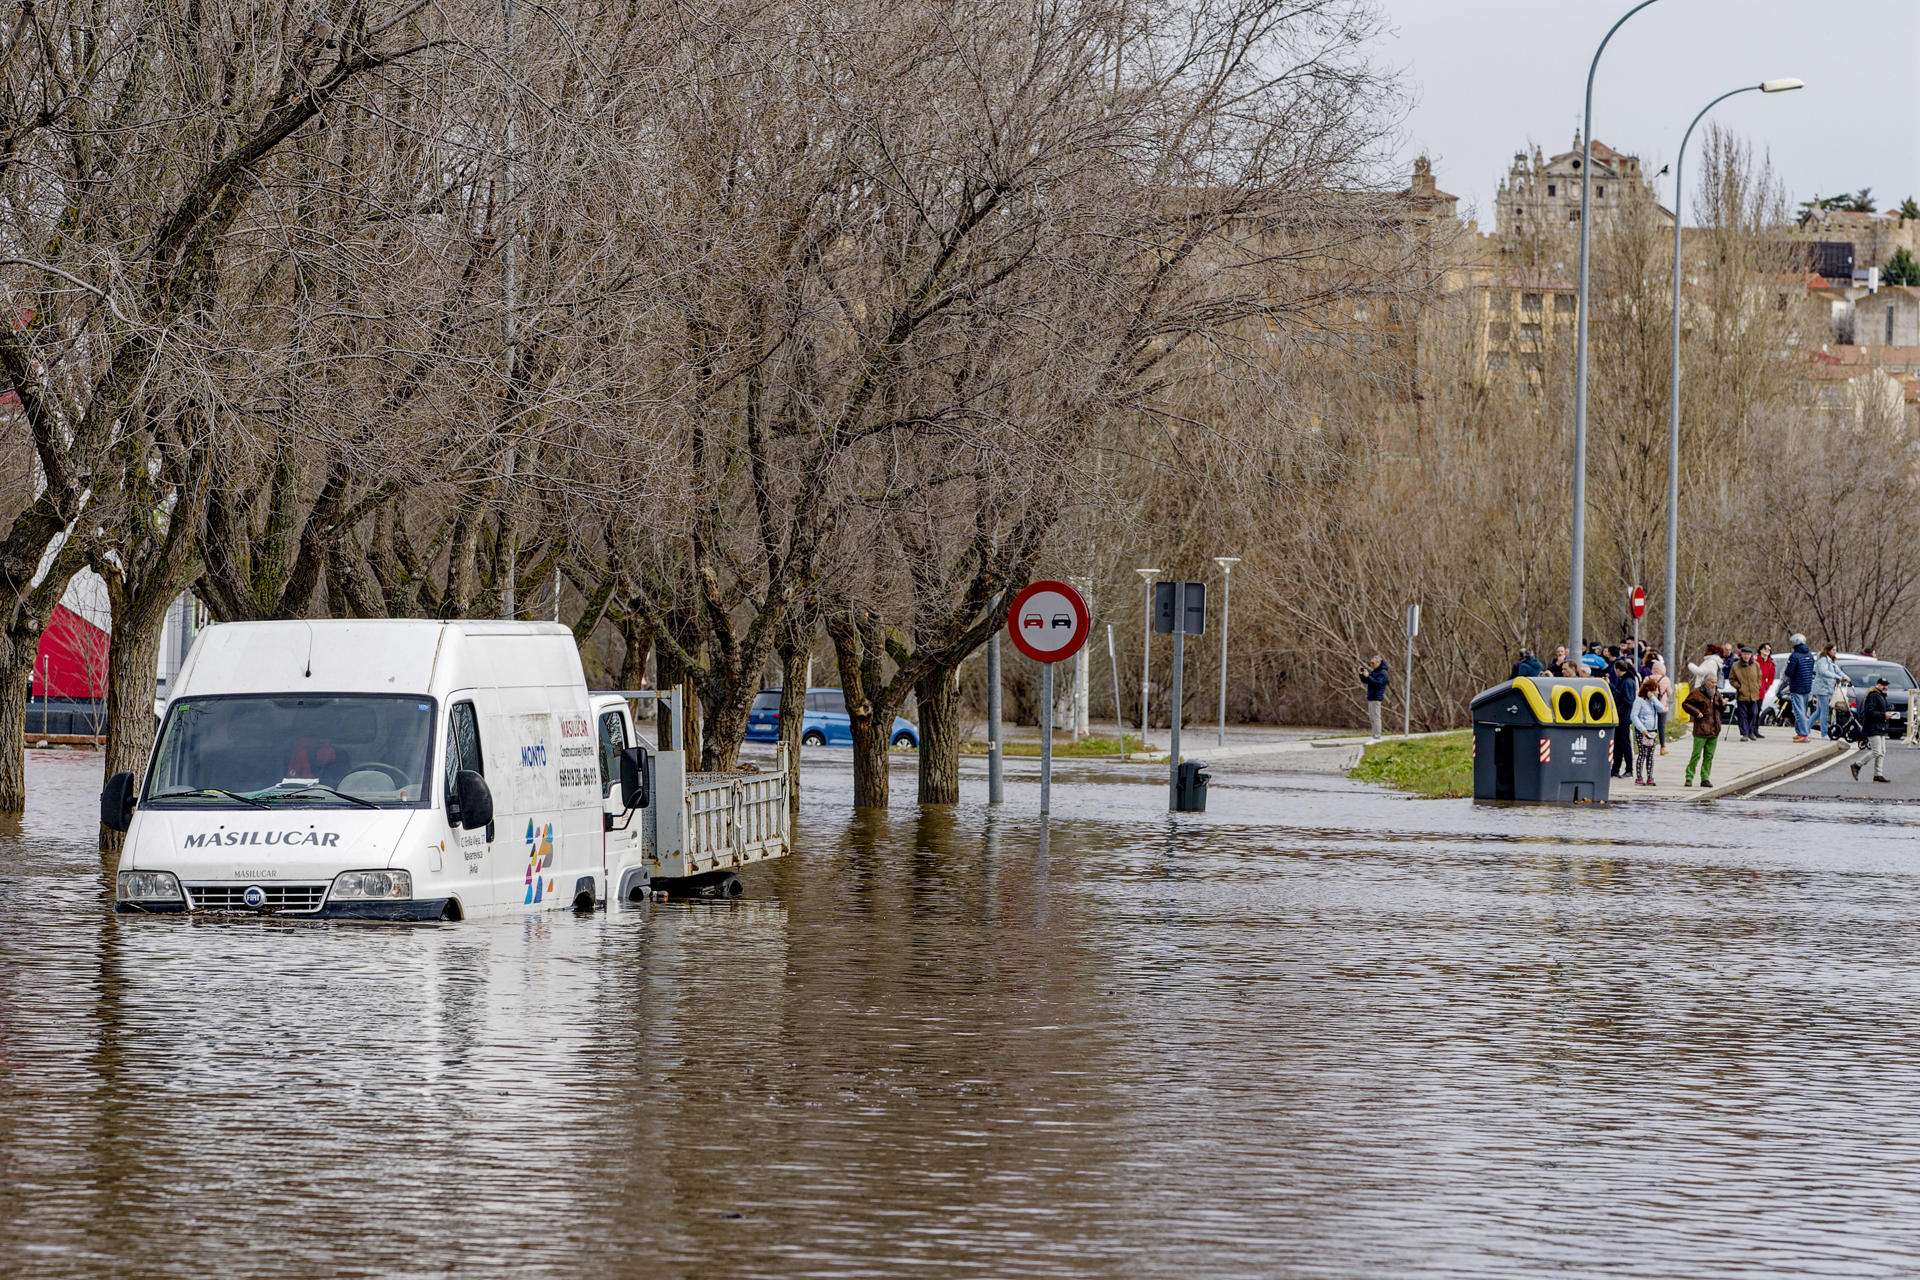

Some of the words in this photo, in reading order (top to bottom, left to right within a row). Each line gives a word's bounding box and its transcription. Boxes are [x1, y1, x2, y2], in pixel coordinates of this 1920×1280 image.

[184, 831, 340, 849] MASILUCAR
[234, 869, 278, 878] MASILUCAR
[246, 893, 261, 901] FIAT
